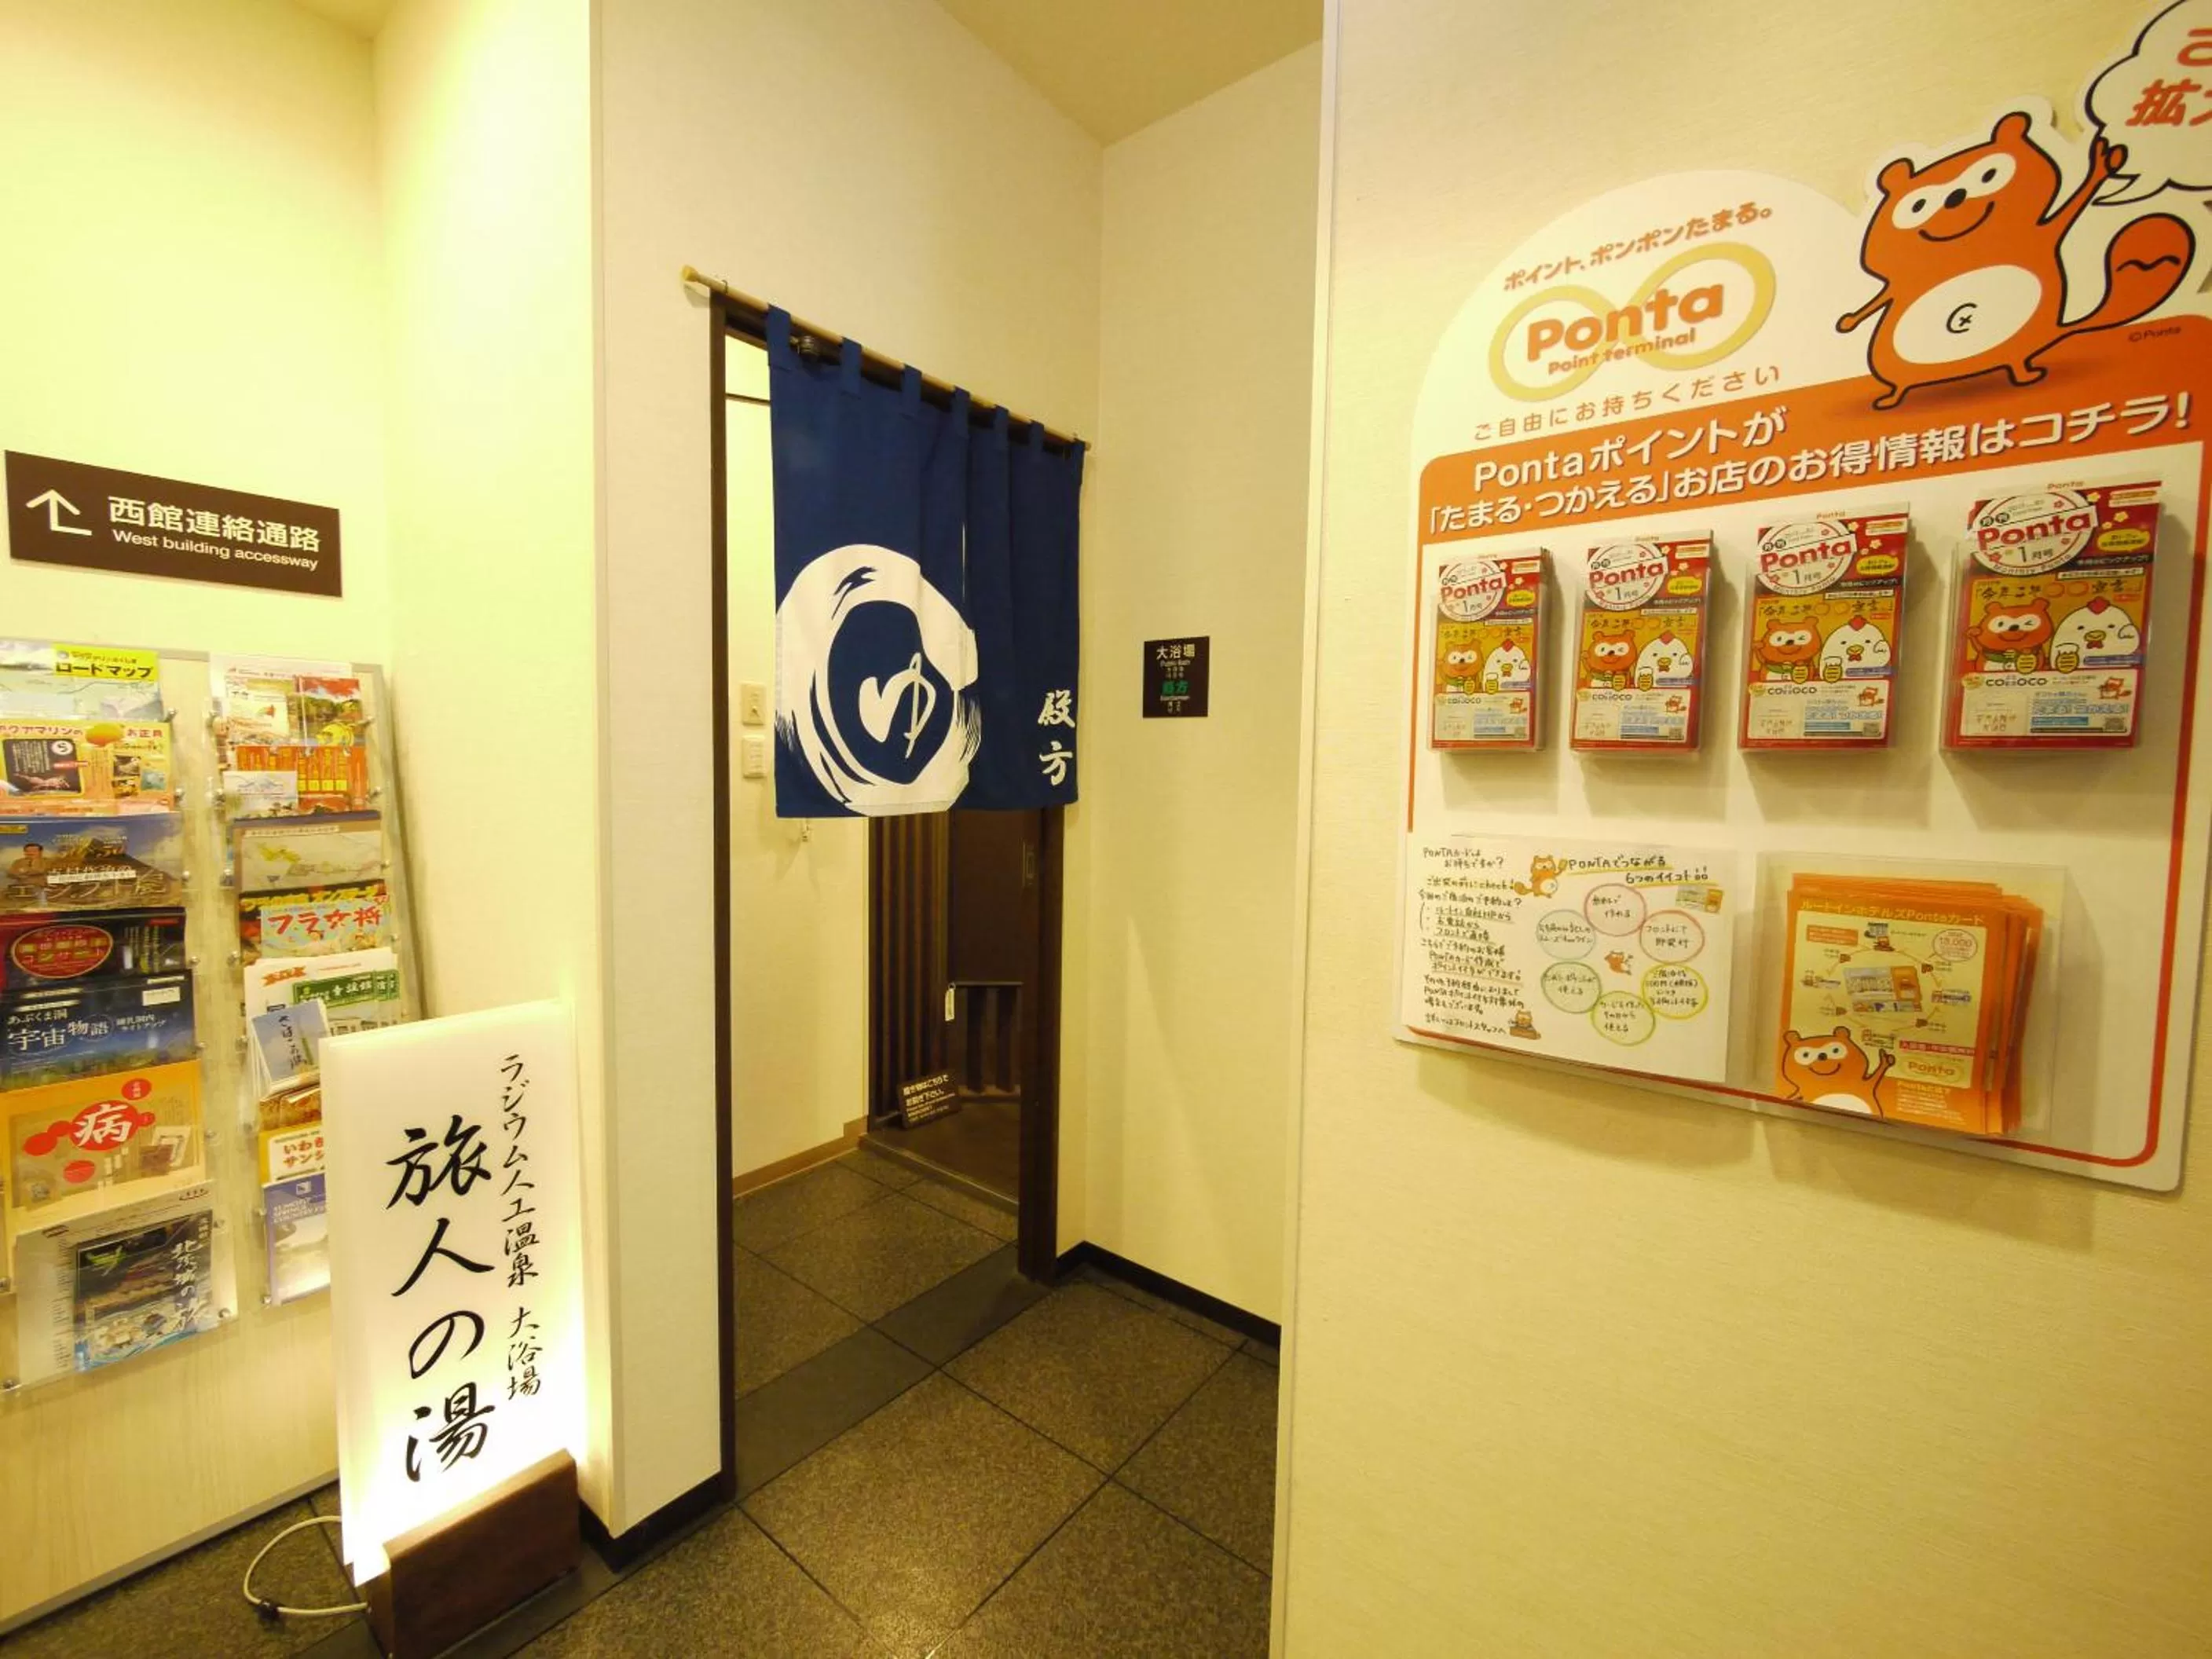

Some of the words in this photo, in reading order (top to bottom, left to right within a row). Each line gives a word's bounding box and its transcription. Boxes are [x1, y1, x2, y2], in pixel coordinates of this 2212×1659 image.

[1504, 201, 1773, 291] ポイント、ポンポンたまる。
[1527, 284, 1724, 362] Ponta
[1548, 352, 1599, 375] Point
[1602, 328, 1695, 362] terminal
[1474, 365, 1779, 441] ご自由にお持ちください
[1474, 405, 1787, 492] Pontaポイントが
[108, 496, 320, 553] 西館連絡通路
[113, 529, 158, 548] West
[163, 534, 230, 559] building
[235, 548, 318, 571] accessway
[1978, 514, 2091, 551] Ponta
[1589, 562, 1664, 588] Ponta
[1760, 540, 1851, 574] Ponta
[1441, 576, 1503, 601] Ponta
[56, 662, 154, 678] ロードマップ
[859, 652, 936, 759] ゆ
[1037, 690, 1076, 786] 殿方
[267, 906, 383, 935] フラ女将
[73, 1103, 132, 1146] 病
[500, 1054, 539, 1288] ラジウム人工温泉
[384, 1114, 496, 1482] 旅人の湯
[507, 1306, 543, 1400] 大浴場
